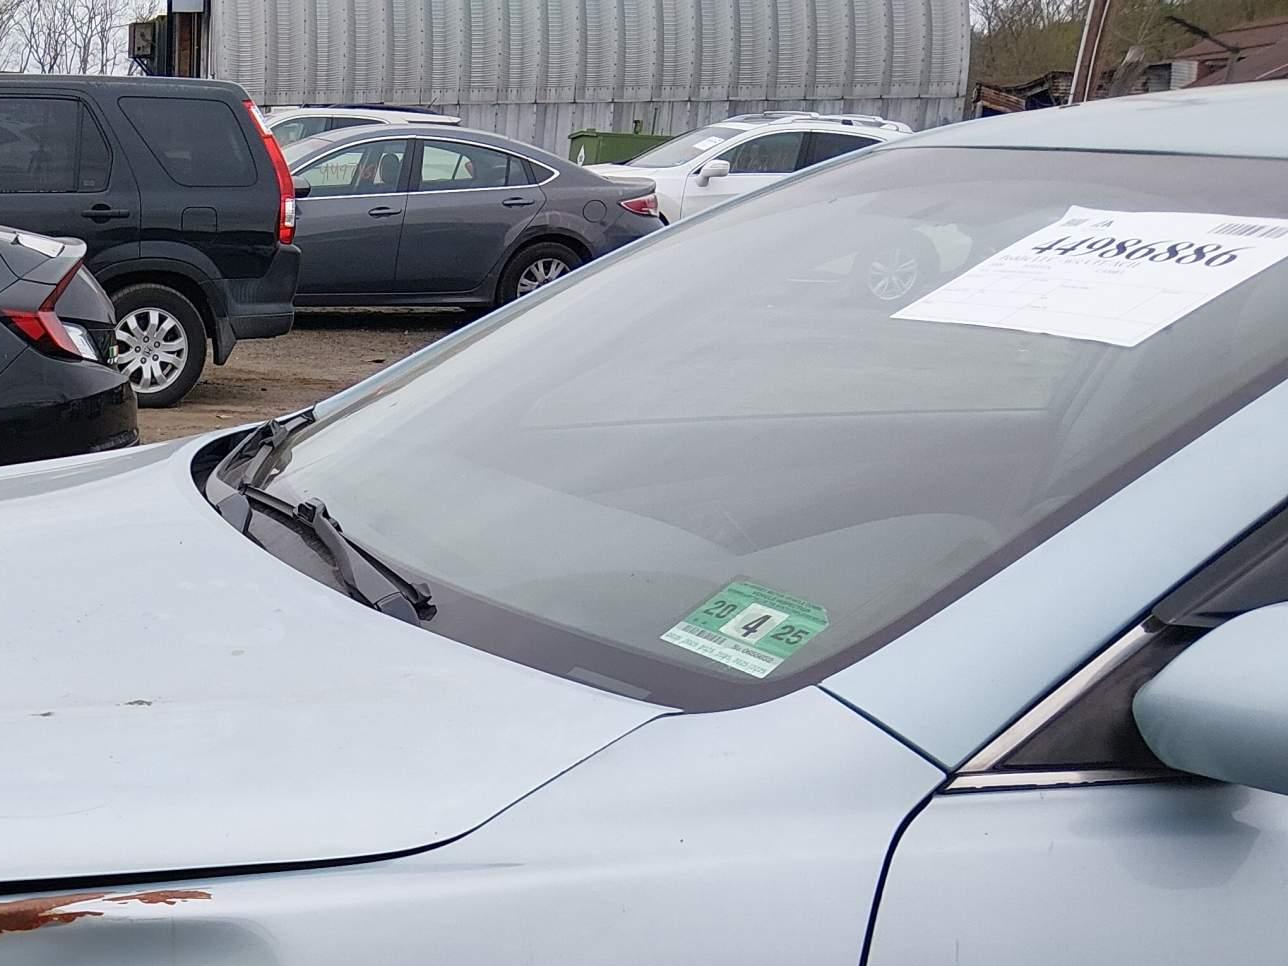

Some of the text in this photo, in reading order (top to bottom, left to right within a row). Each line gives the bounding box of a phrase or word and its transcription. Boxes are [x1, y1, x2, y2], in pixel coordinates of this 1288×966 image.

[1032, 236, 1256, 268] 44986886
[702, 600, 737, 619] 20
[741, 614, 772, 638] 4
[770, 625, 810, 645] 25
